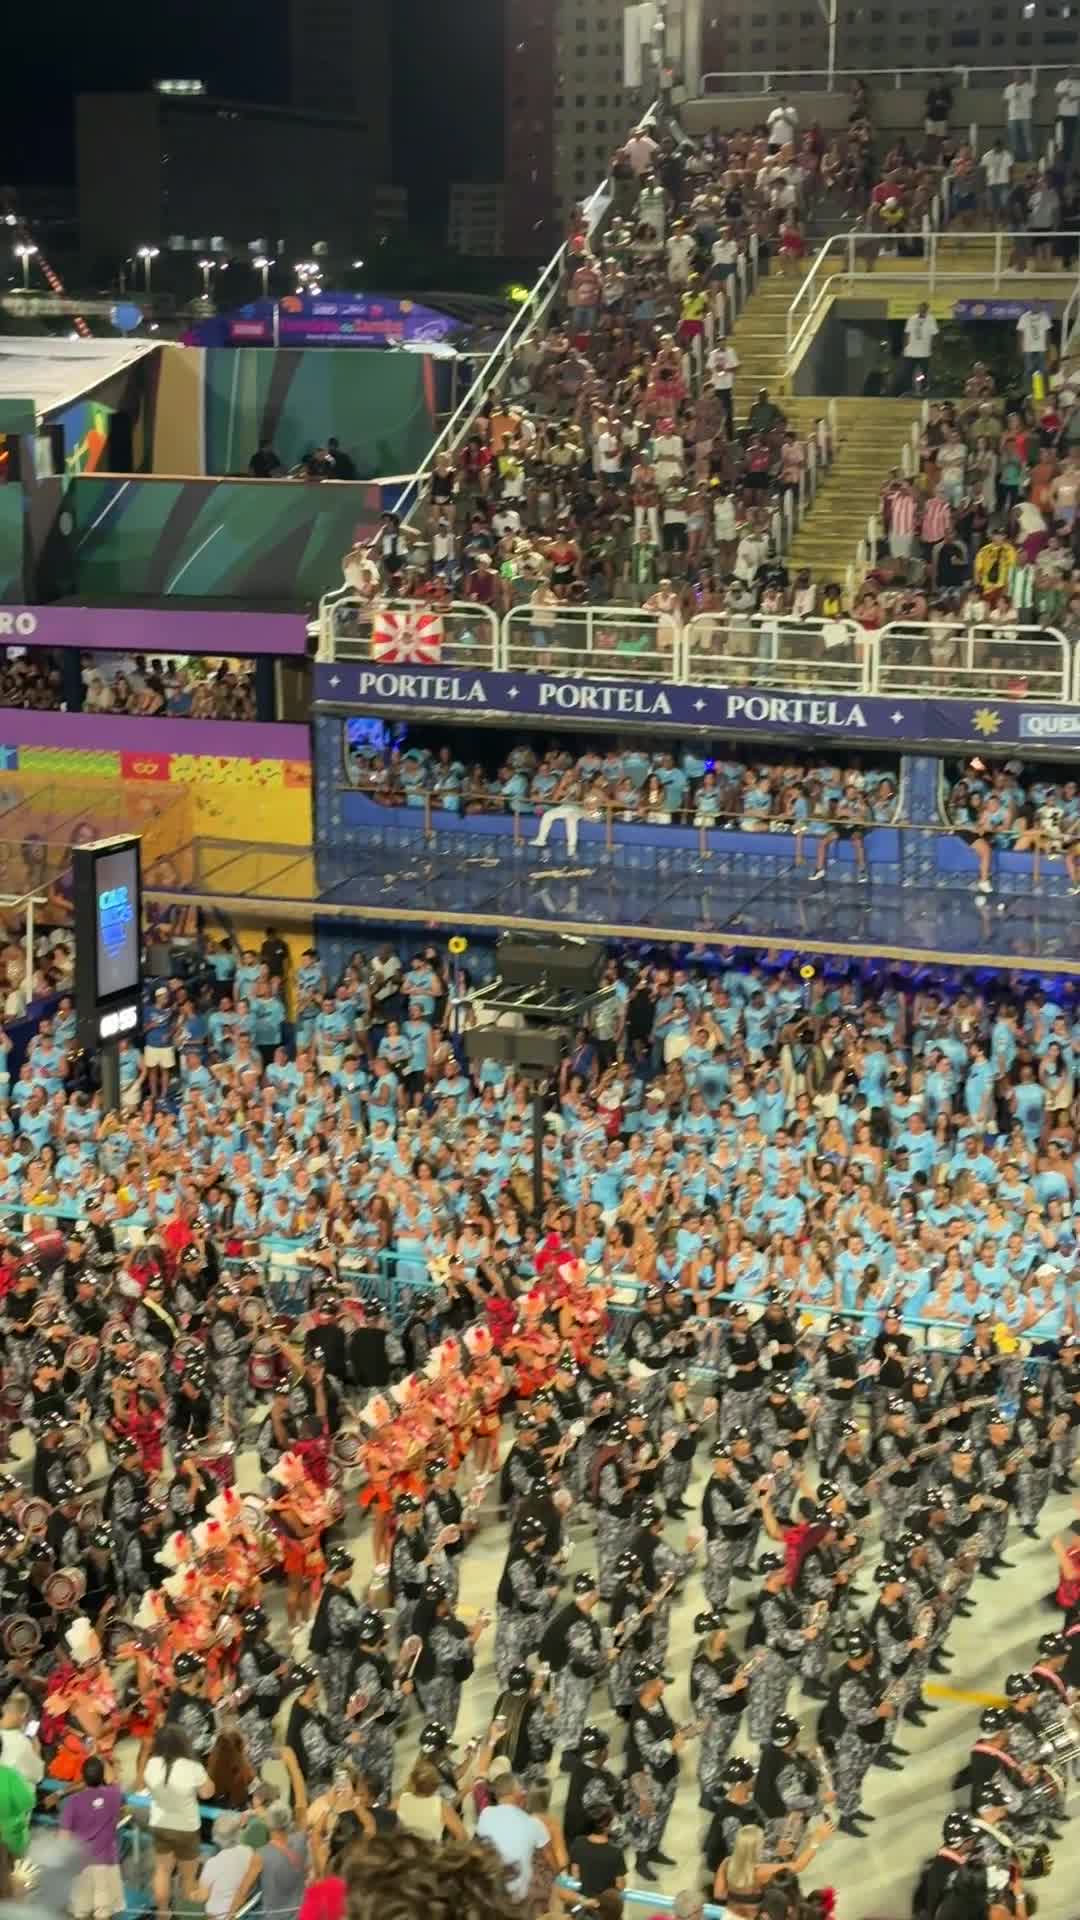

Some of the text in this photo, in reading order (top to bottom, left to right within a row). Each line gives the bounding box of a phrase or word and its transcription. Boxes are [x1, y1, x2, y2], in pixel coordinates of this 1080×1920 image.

[359, 672, 487, 702] PORTELA
[539, 684, 673, 714] PORTELA
[726, 695, 867, 727] PORTELA
